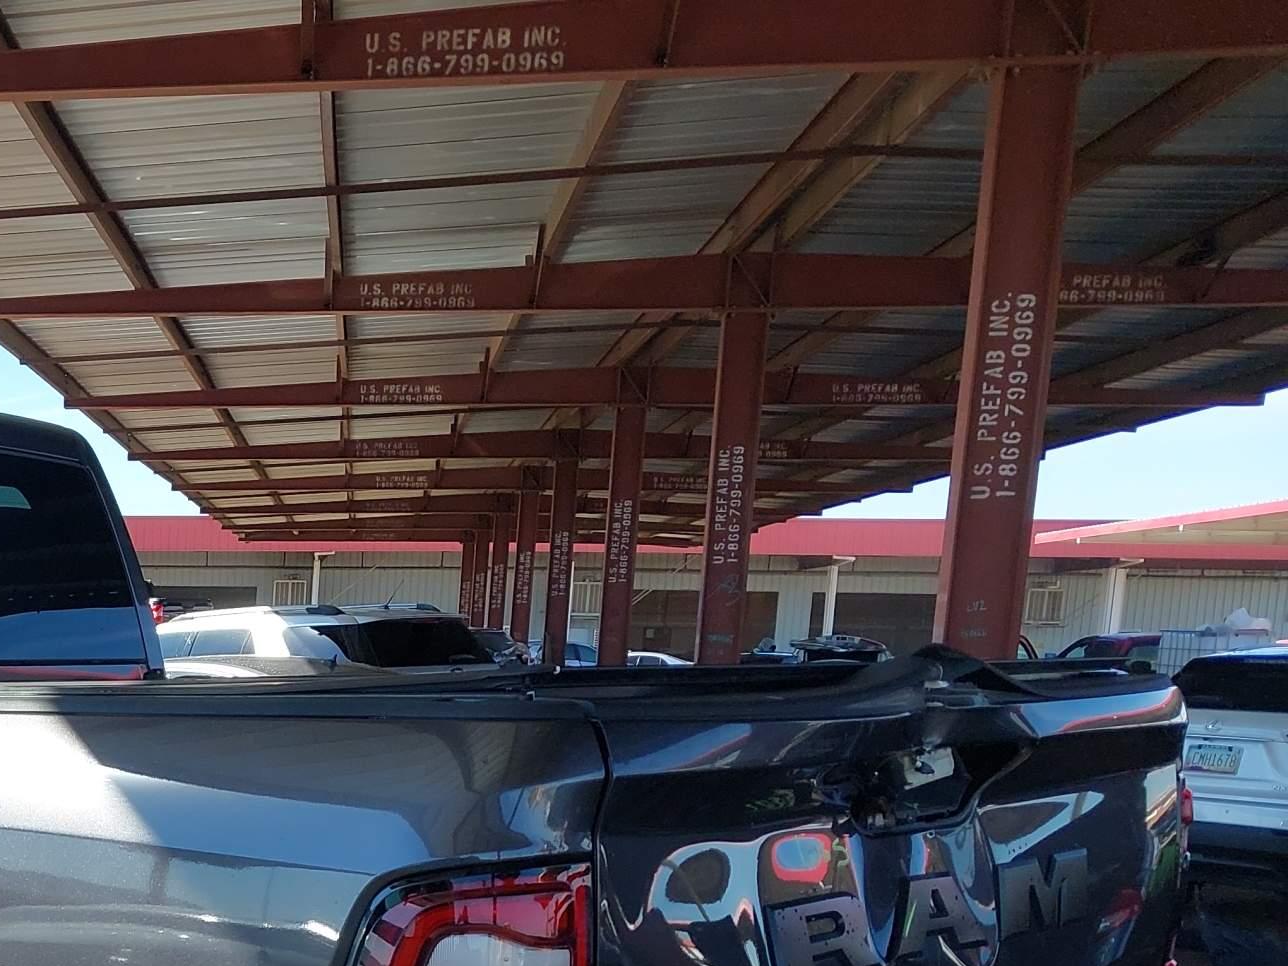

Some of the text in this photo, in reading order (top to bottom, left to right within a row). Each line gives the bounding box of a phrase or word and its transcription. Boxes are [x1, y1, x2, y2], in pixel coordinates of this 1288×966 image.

[365, 25, 567, 53] U.S. PREFAB INC.
[366, 50, 565, 77] 1-866-799-0969
[392, 282, 445, 295] PREFAB
[1073, 274, 1132, 288] PREFAB
[970, 291, 1014, 500] U.S. PREFAB INC.
[996, 292, 1037, 498] 1-866-799-0969
[714, 478, 730, 531] PREFAB
